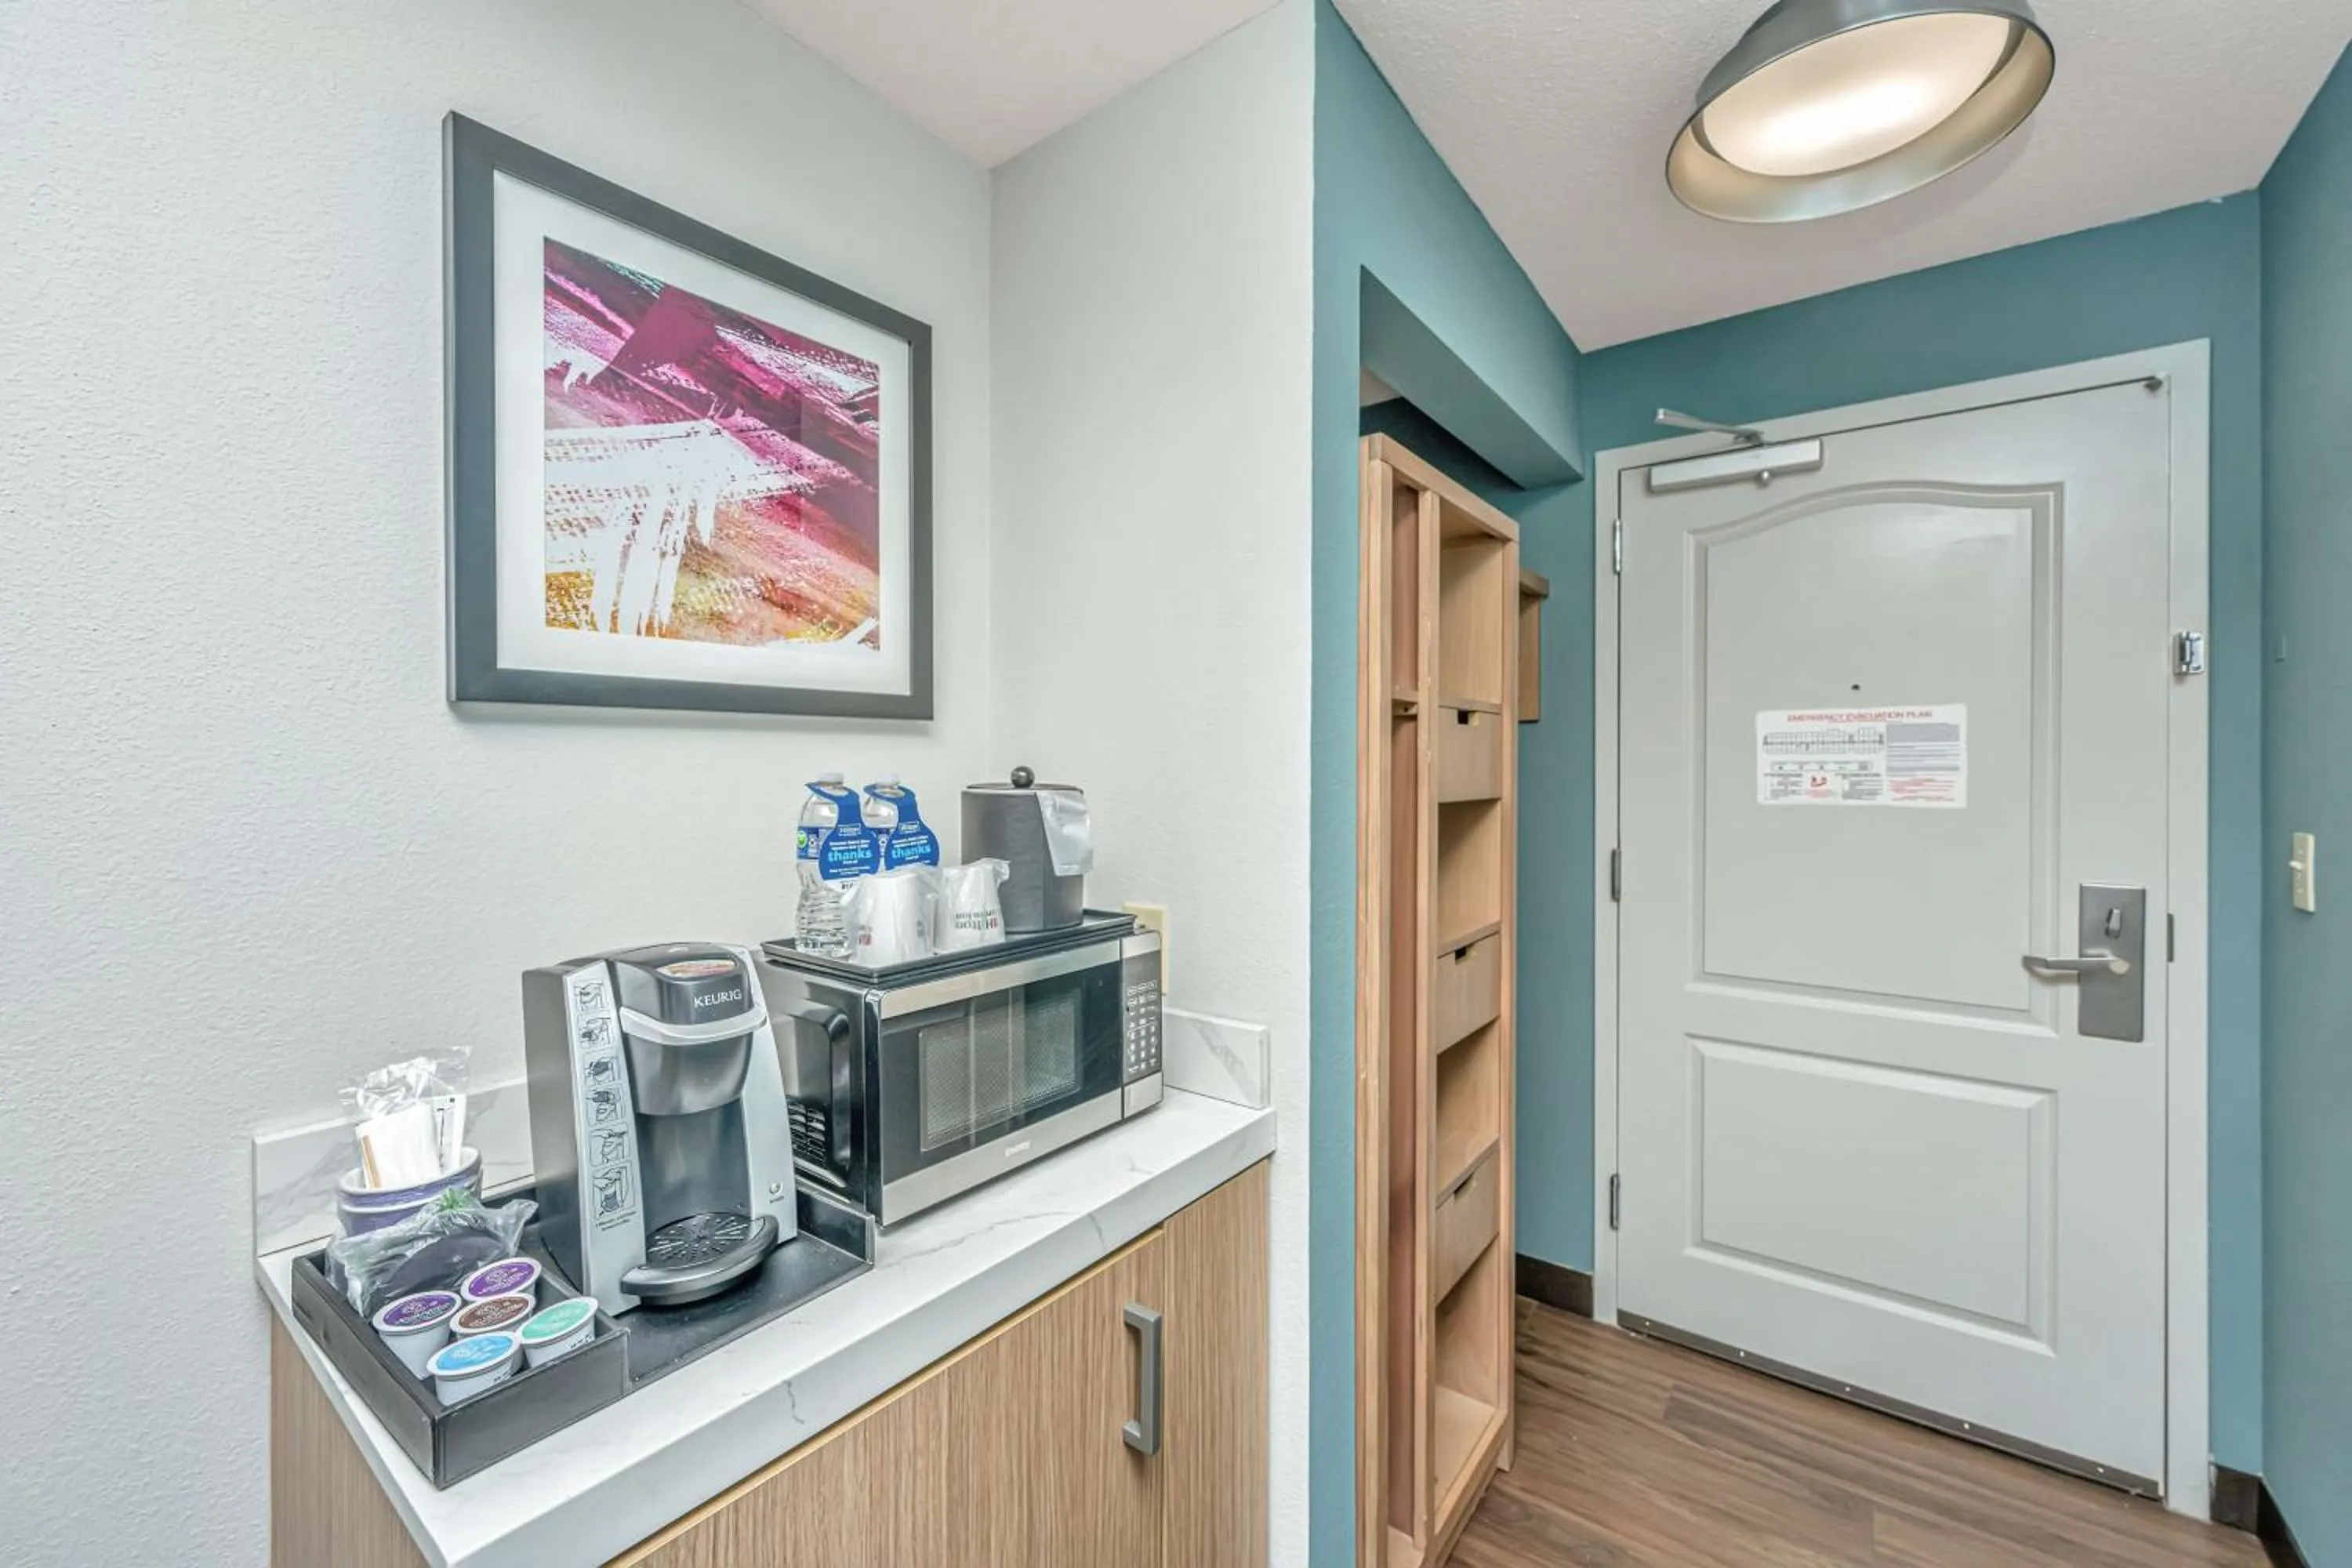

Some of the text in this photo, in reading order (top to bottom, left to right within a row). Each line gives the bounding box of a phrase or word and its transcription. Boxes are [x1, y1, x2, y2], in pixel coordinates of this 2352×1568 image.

[828, 850, 873, 862] thanks
[891, 845, 931, 858] thanks
[694, 988, 742, 1008] KEURIG
